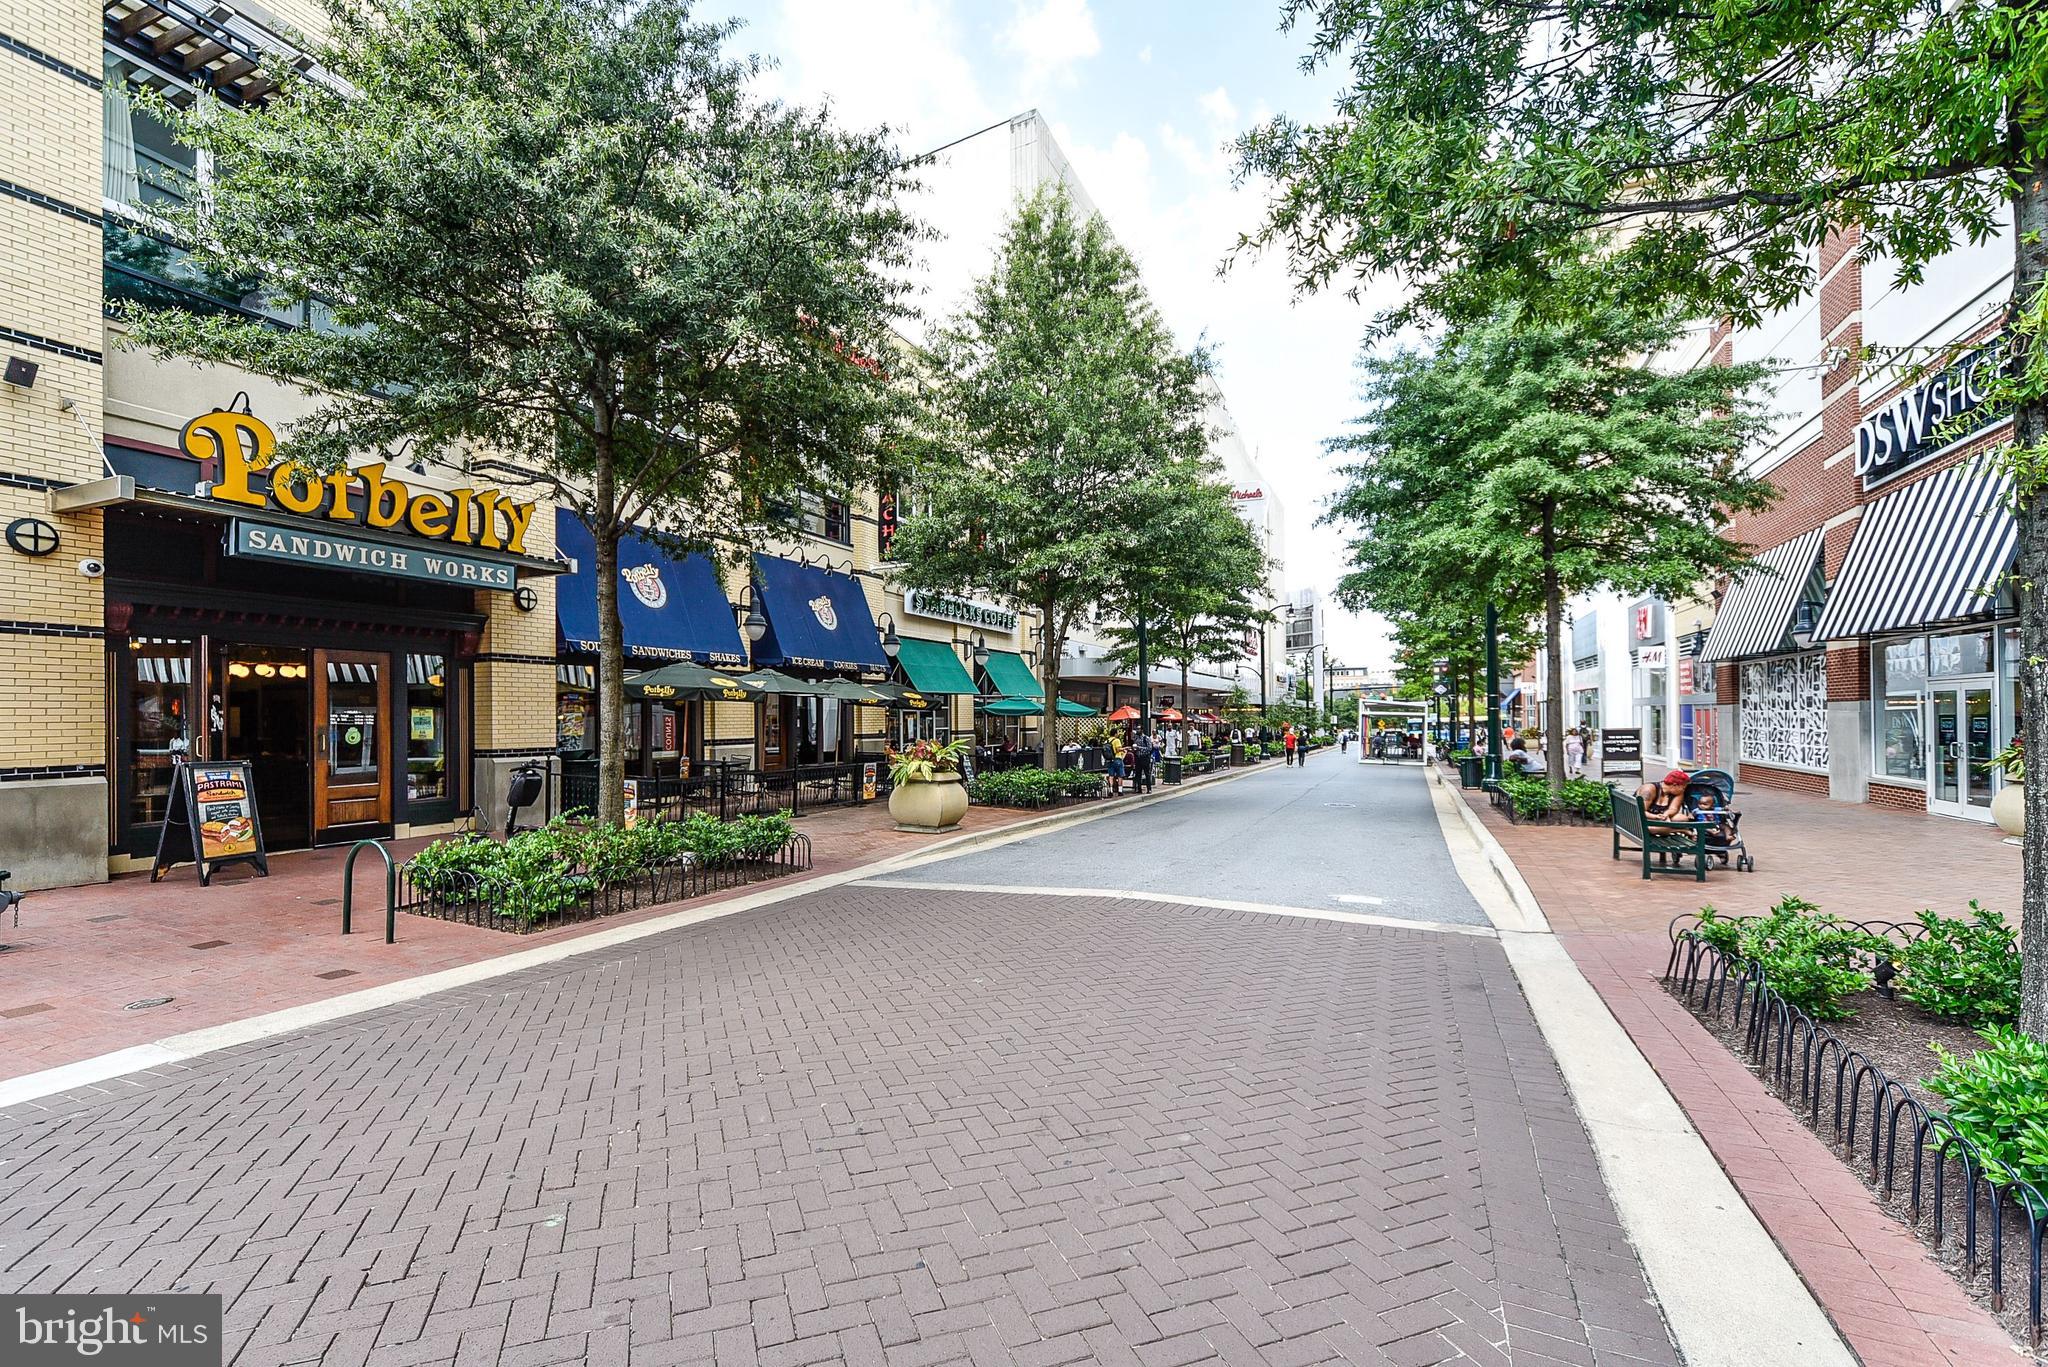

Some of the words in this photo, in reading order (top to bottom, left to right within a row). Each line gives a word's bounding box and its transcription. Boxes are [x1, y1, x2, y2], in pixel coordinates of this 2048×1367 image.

[1853, 384, 1931, 477] DSW
[179, 411, 536, 554] Potbelly
[249, 530, 408, 570] SANDWICH
[424, 557, 509, 584] WORKS
[915, 591, 982, 622] SARBUCKS
[984, 609, 1018, 629] COFFEE
[631, 645, 692, 660] SANDWICHES
[709, 652, 741, 663] SHAKES
[791, 656, 802, 666] ICE
[803, 658, 824, 668] CREAM
[833, 661, 858, 670] COOKIES
[643, 684, 675, 697] Potbelly
[722, 688, 747, 699] Potbelly
[197, 780, 243, 792] PASTRAMI
